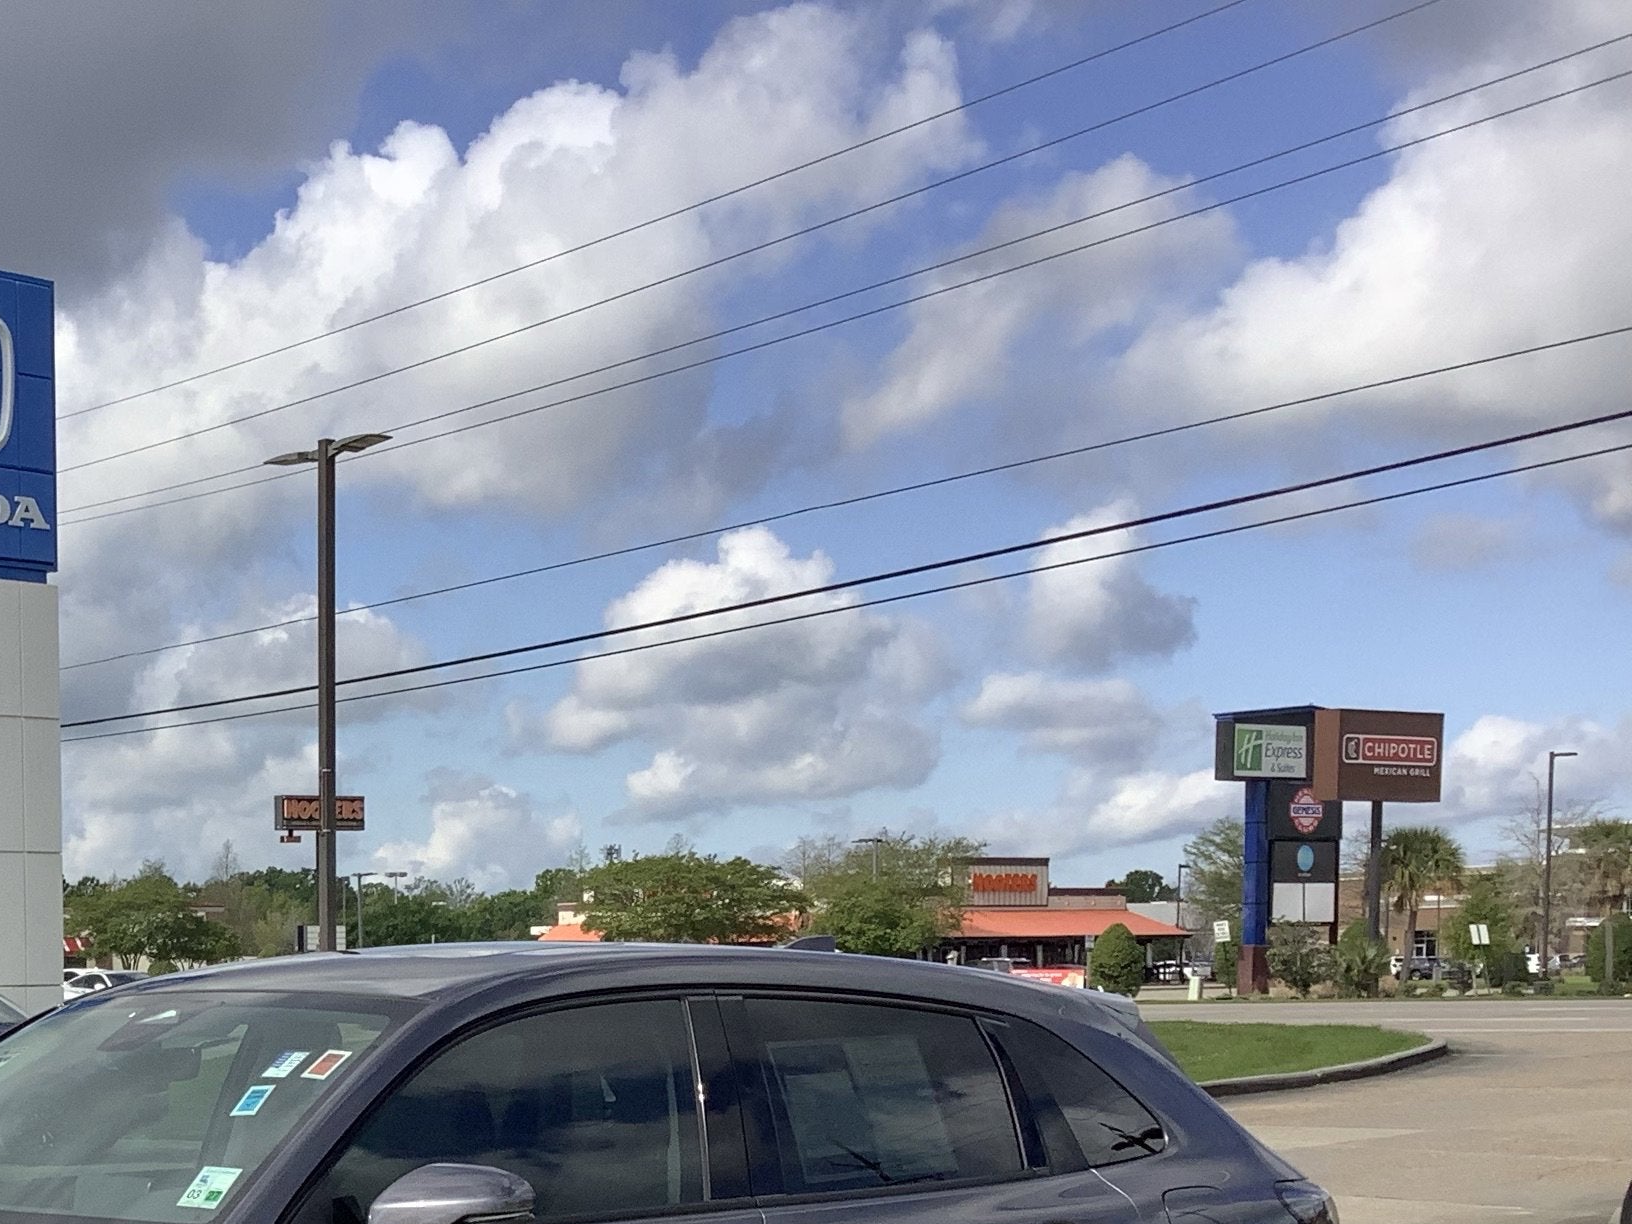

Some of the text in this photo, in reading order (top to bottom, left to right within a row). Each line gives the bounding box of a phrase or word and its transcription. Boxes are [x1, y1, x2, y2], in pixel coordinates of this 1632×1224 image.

[1265, 742, 1303, 760] Express
[1364, 742, 1432, 759] CHIPOTLE
[1373, 767, 1430, 777] MEXICAN GRILL
[284, 800, 363, 819] HOOERS
[186, 1189, 202, 1199] 03
